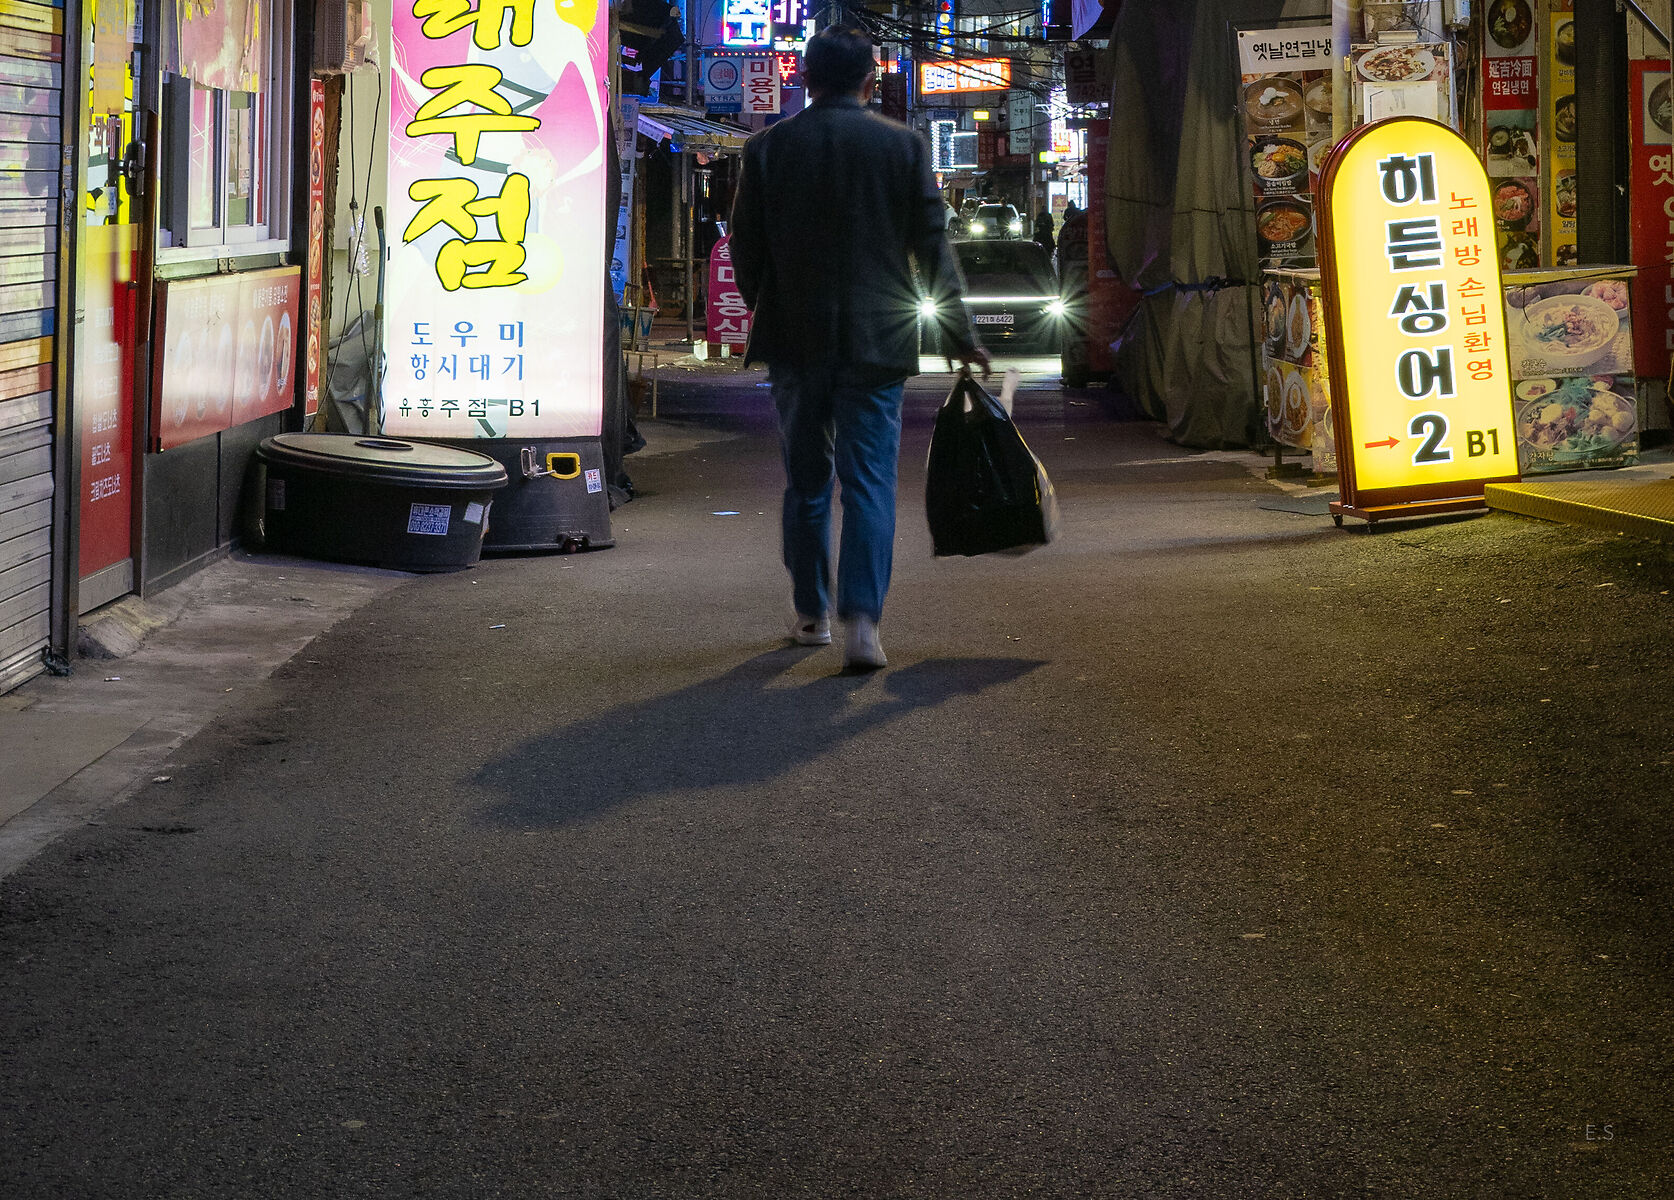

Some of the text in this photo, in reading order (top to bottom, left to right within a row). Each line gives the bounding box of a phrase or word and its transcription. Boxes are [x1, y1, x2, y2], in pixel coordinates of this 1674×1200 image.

[1488, 59, 1533, 79] 延吉冷面
[748, 59, 776, 112] 미용실
[1491, 79, 1530, 96] 연길냉면
[410, 321, 525, 348] 도우미
[410, 353, 525, 381] 항시대기
[399, 398, 541, 418] 유흥주점 B1
[1466, 428, 1500, 459] B1
